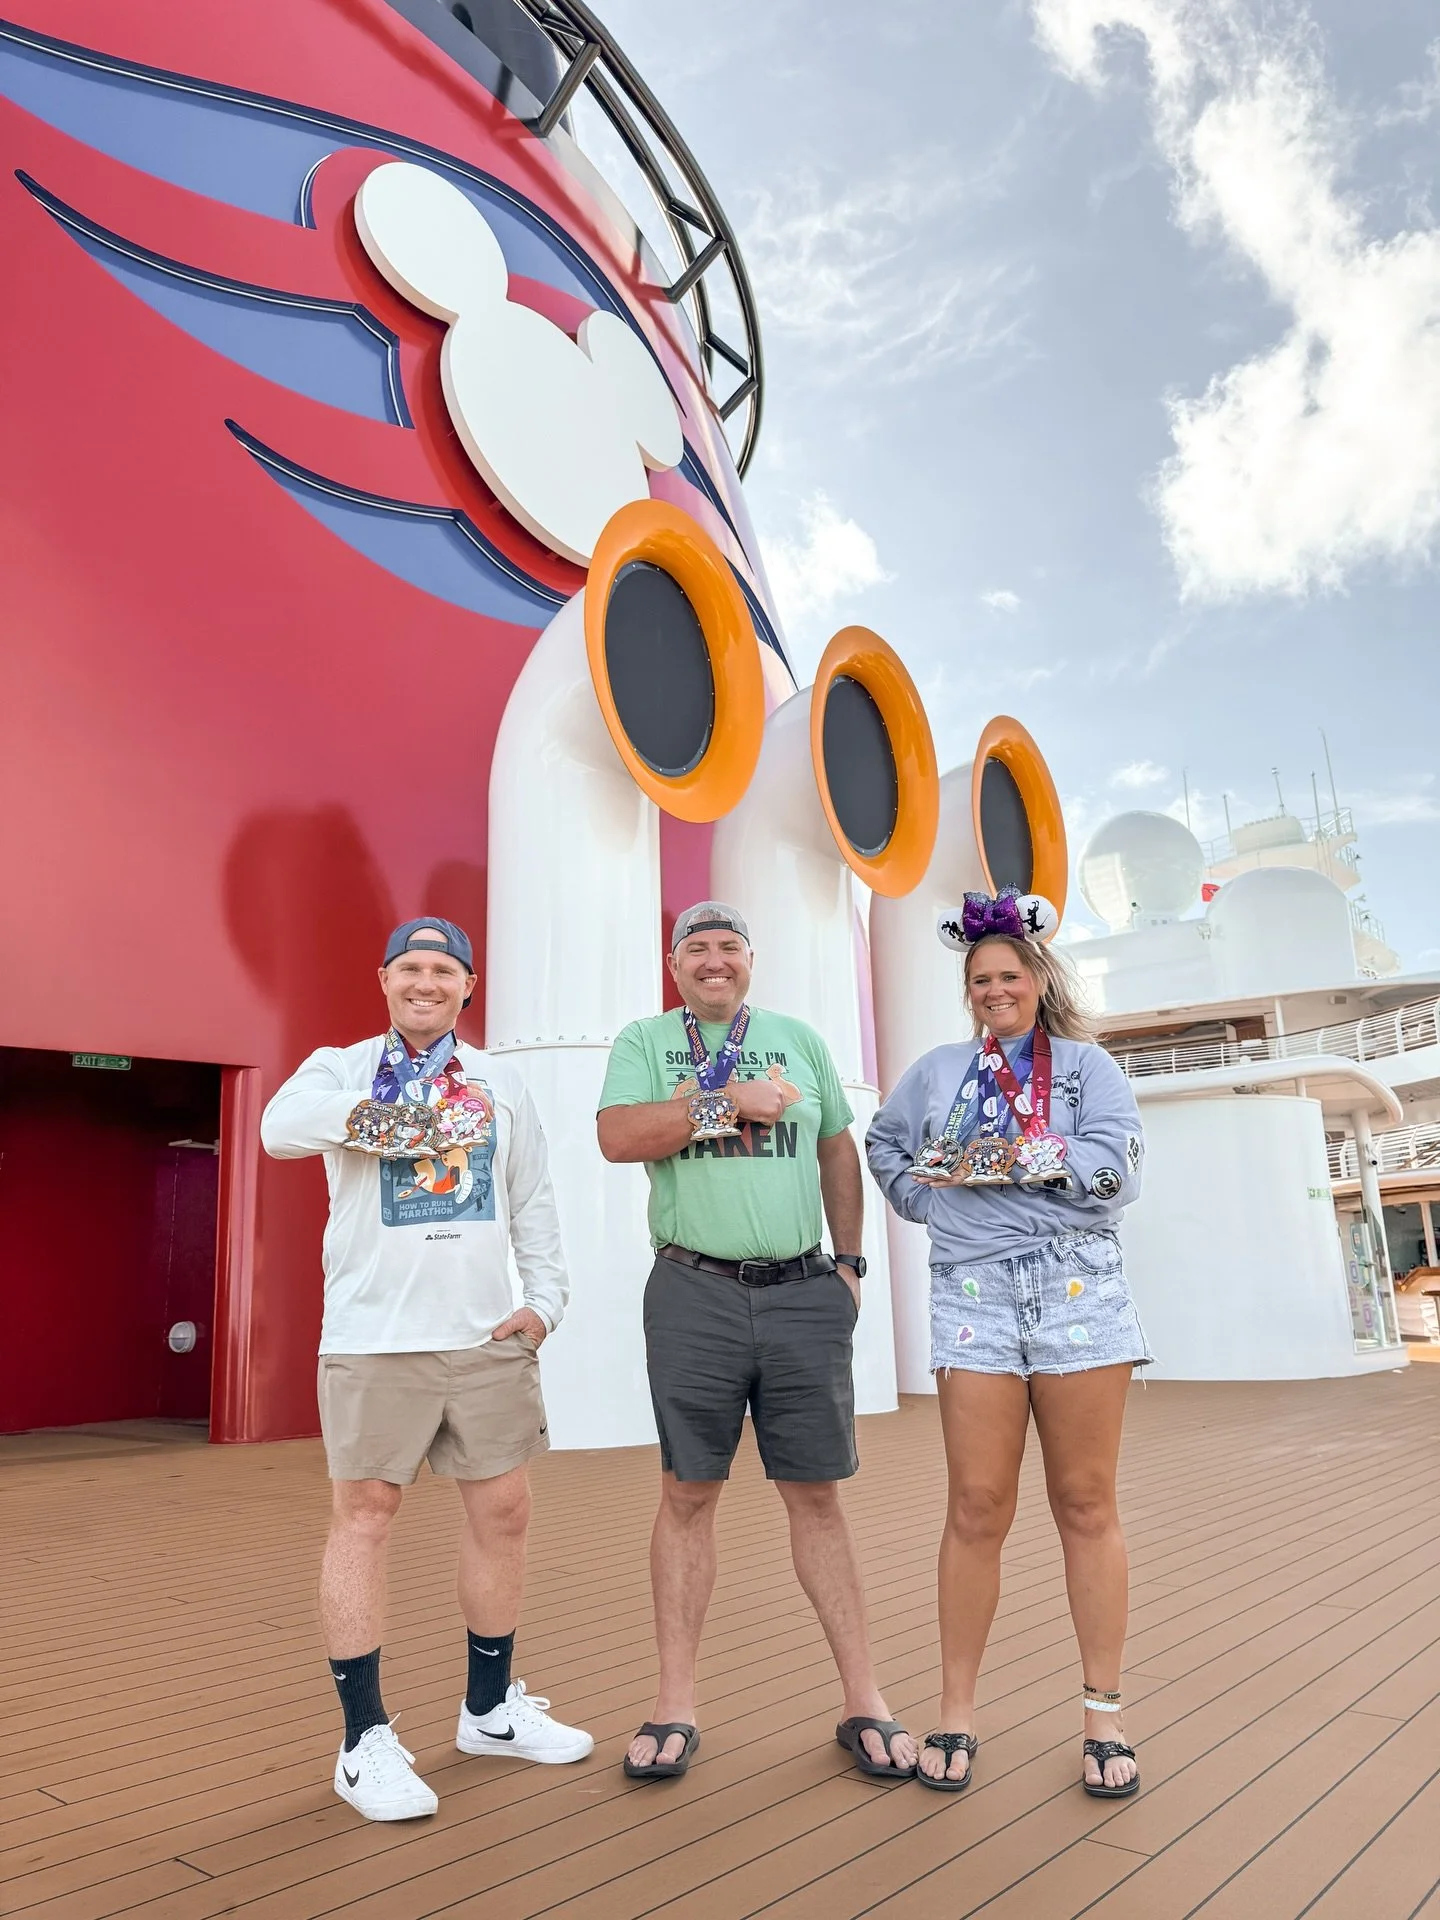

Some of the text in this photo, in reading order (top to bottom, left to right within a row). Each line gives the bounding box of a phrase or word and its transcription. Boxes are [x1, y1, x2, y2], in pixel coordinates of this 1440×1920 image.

[75, 1055, 96, 1066] EXIT
[665, 1050, 710, 1066] SOR
[765, 1051, 787, 1067] I'M
[680, 1120, 798, 1160] AKEN
[1095, 1170, 1117, 1195] 10K
[399, 1203, 418, 1211] HOW
[399, 1207, 453, 1219] MARATHON
